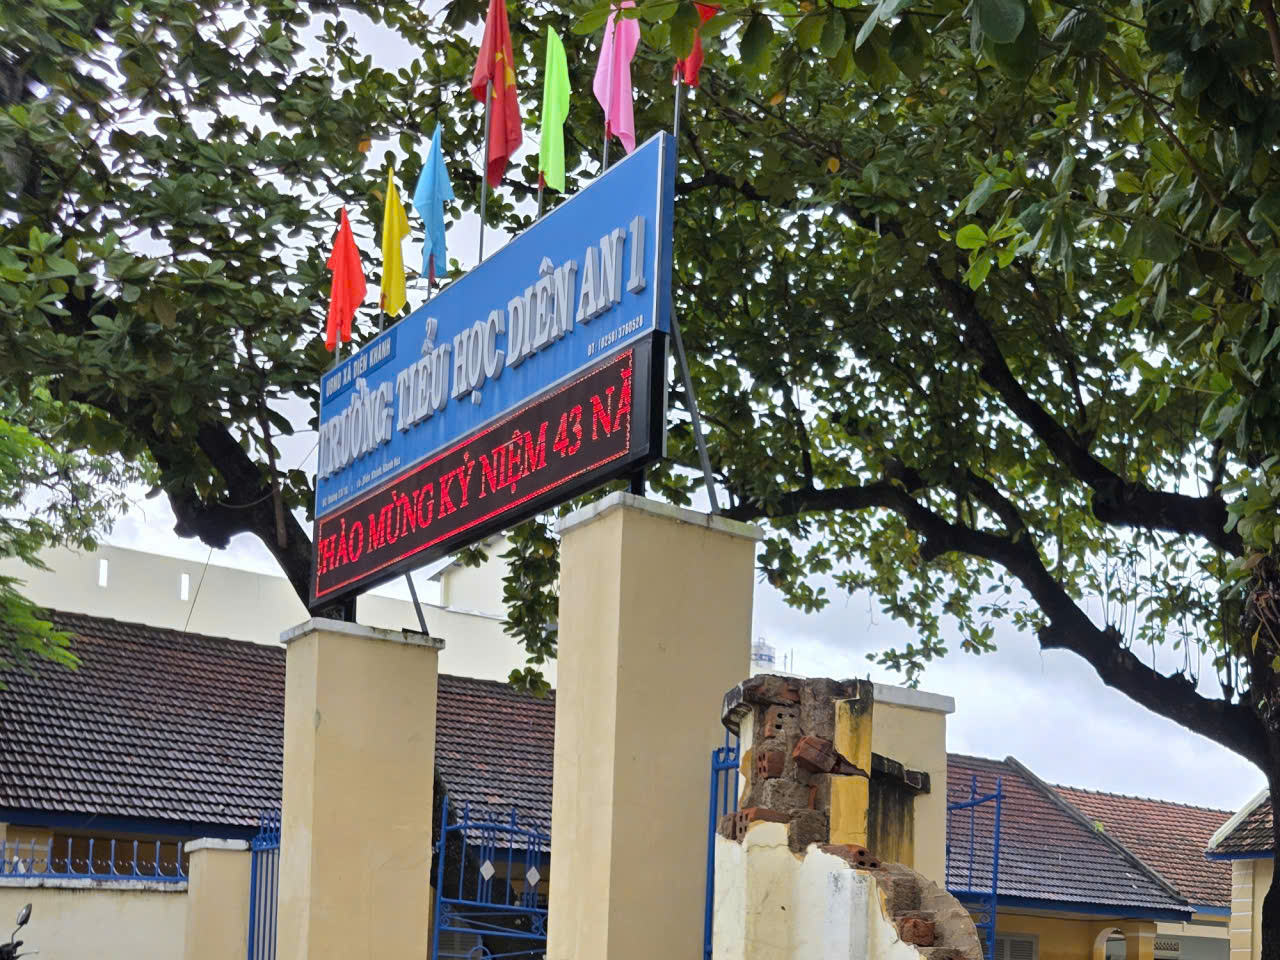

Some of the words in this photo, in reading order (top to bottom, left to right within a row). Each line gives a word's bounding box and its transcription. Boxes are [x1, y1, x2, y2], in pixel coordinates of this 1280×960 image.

[317, 377, 394, 480] TRƯỜNG
[396, 317, 452, 433] TIỂU
[451, 309, 506, 405] HỌC
[506, 256, 578, 369] DIÊN
[576, 227, 627, 326] AN
[627, 215, 647, 294] 1
[366, 482, 435, 554] MỪNG
[478, 421, 549, 499] NIỆM
[553, 404, 583, 458] 43
